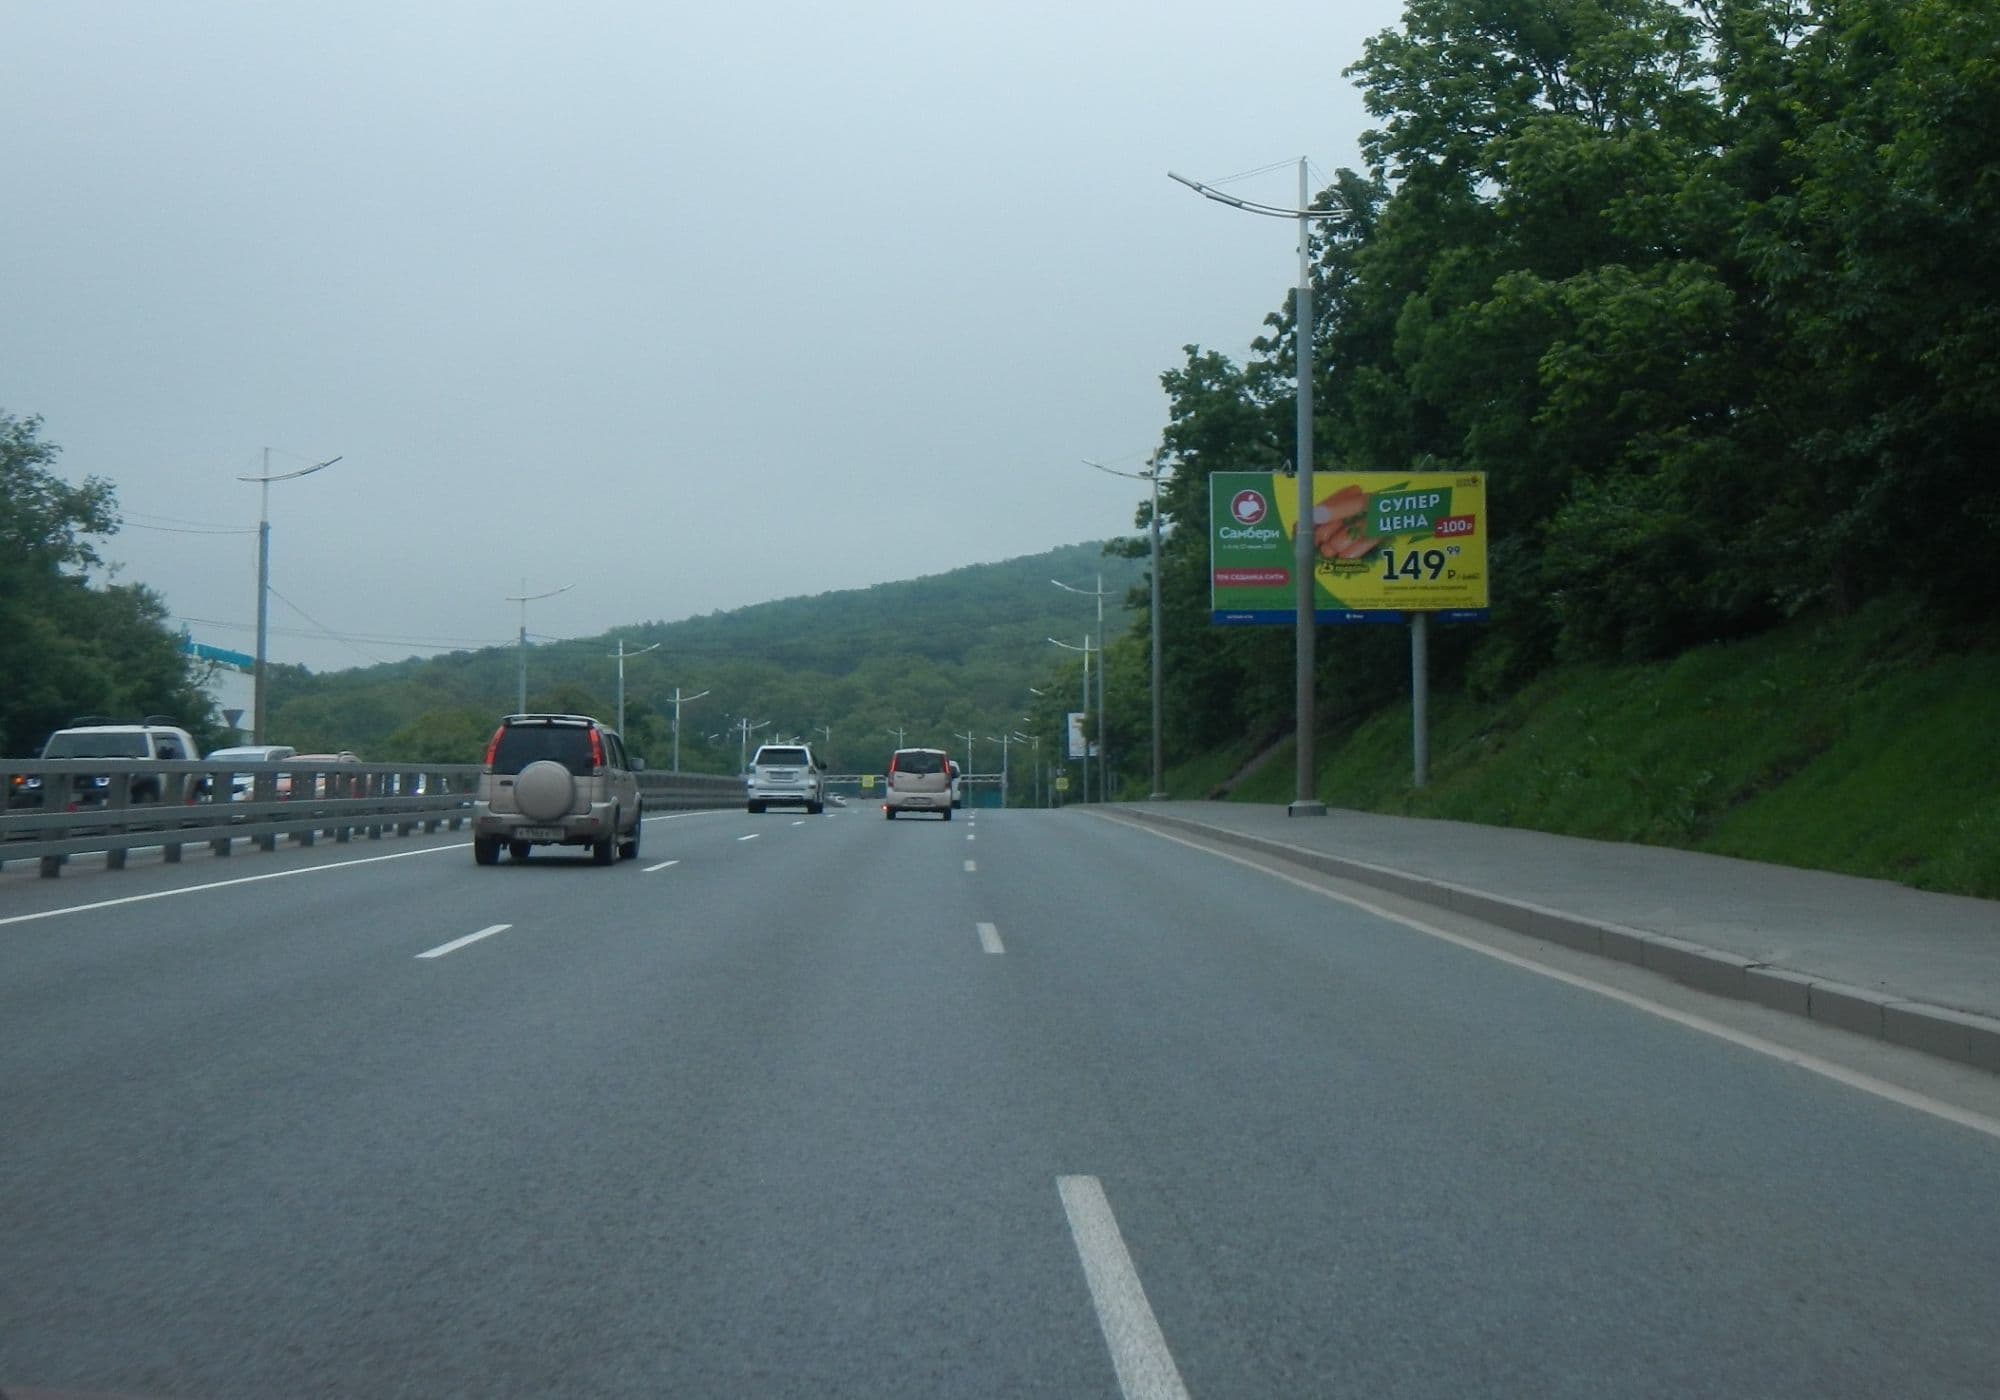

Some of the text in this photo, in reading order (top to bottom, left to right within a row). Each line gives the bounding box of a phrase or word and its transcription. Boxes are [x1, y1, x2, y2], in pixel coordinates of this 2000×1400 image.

[1379, 494, 1440, 513] СУПЕР
[1379, 514, 1429, 531] ЦЕНА
[1219, 526, 1280, 542] Самбери
[1383, 549, 1446, 580] 149
